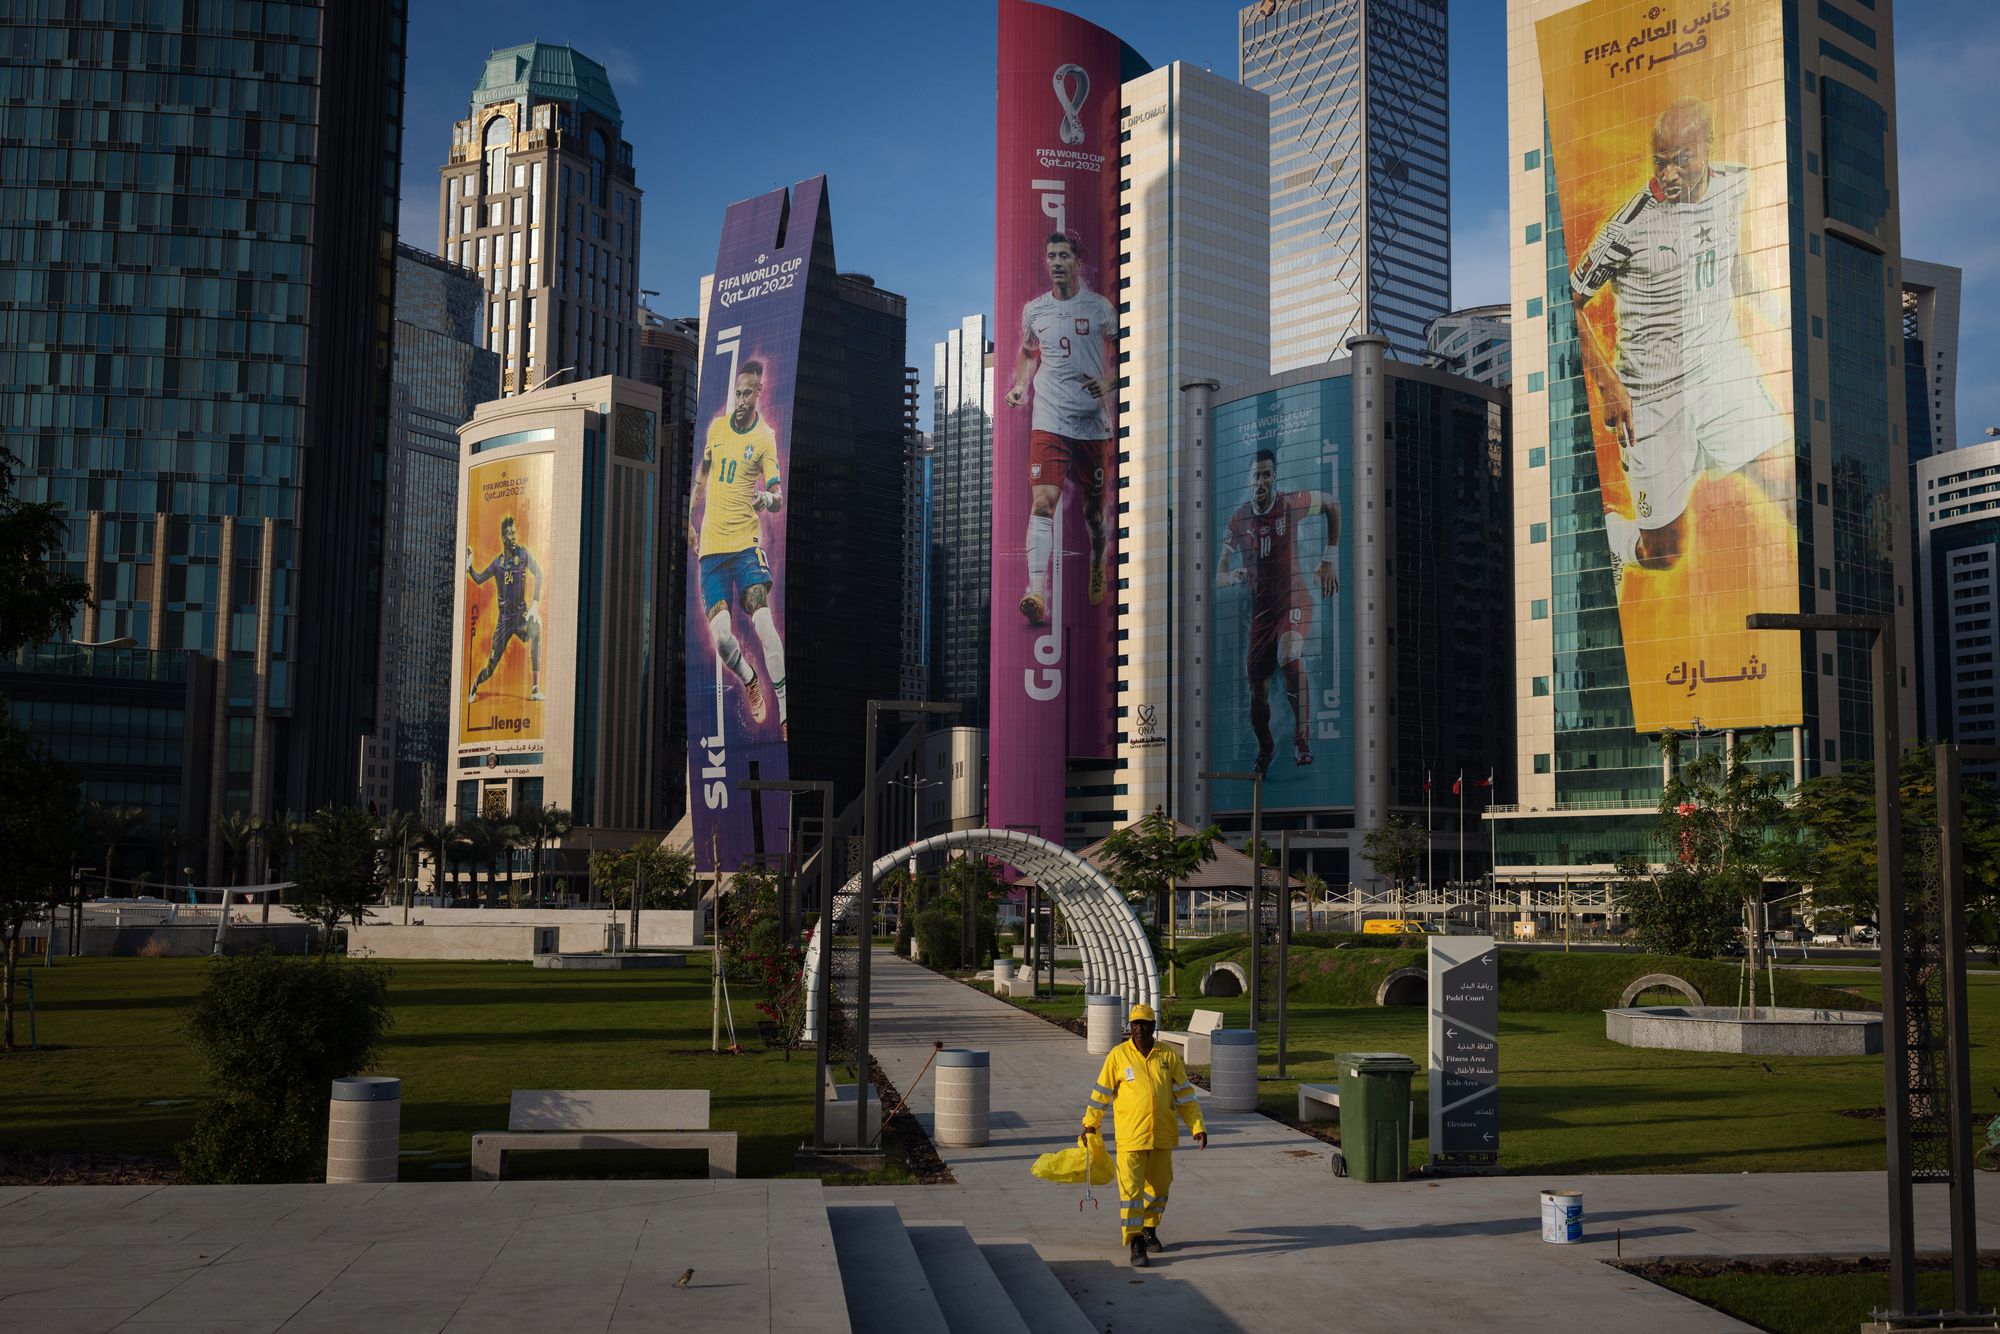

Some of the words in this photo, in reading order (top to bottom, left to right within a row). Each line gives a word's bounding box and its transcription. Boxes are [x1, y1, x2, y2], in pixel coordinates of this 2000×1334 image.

[1682, 1, 1731, 34] كأس
[1626, 18, 1677, 54] العالم
[1584, 39, 1622, 64] FIFA
[1127, 104, 1167, 128] DIPLOMAT
[1036, 148, 1056, 157] FIFA
[1056, 150, 1089, 161] WORLD
[1089, 153, 1105, 163] CUP
[718, 275, 740, 292] FIFA
[741, 264, 780, 286] WORLD
[780, 256, 802, 274] CUP
[1695, 249, 1716, 292] 10
[1059, 336, 1072, 358] 9
[1240, 420, 1258, 433] FIFA
[1293, 407, 1313, 420] CUP
[718, 457, 737, 485] 10
[482, 482, 494, 492] FIFA
[494, 479, 515, 489] WORLD
[515, 476, 529, 486] CUP
[1260, 535, 1271, 559] 10
[504, 571, 514, 585] 24
[1138, 726, 1155, 736] QNA
